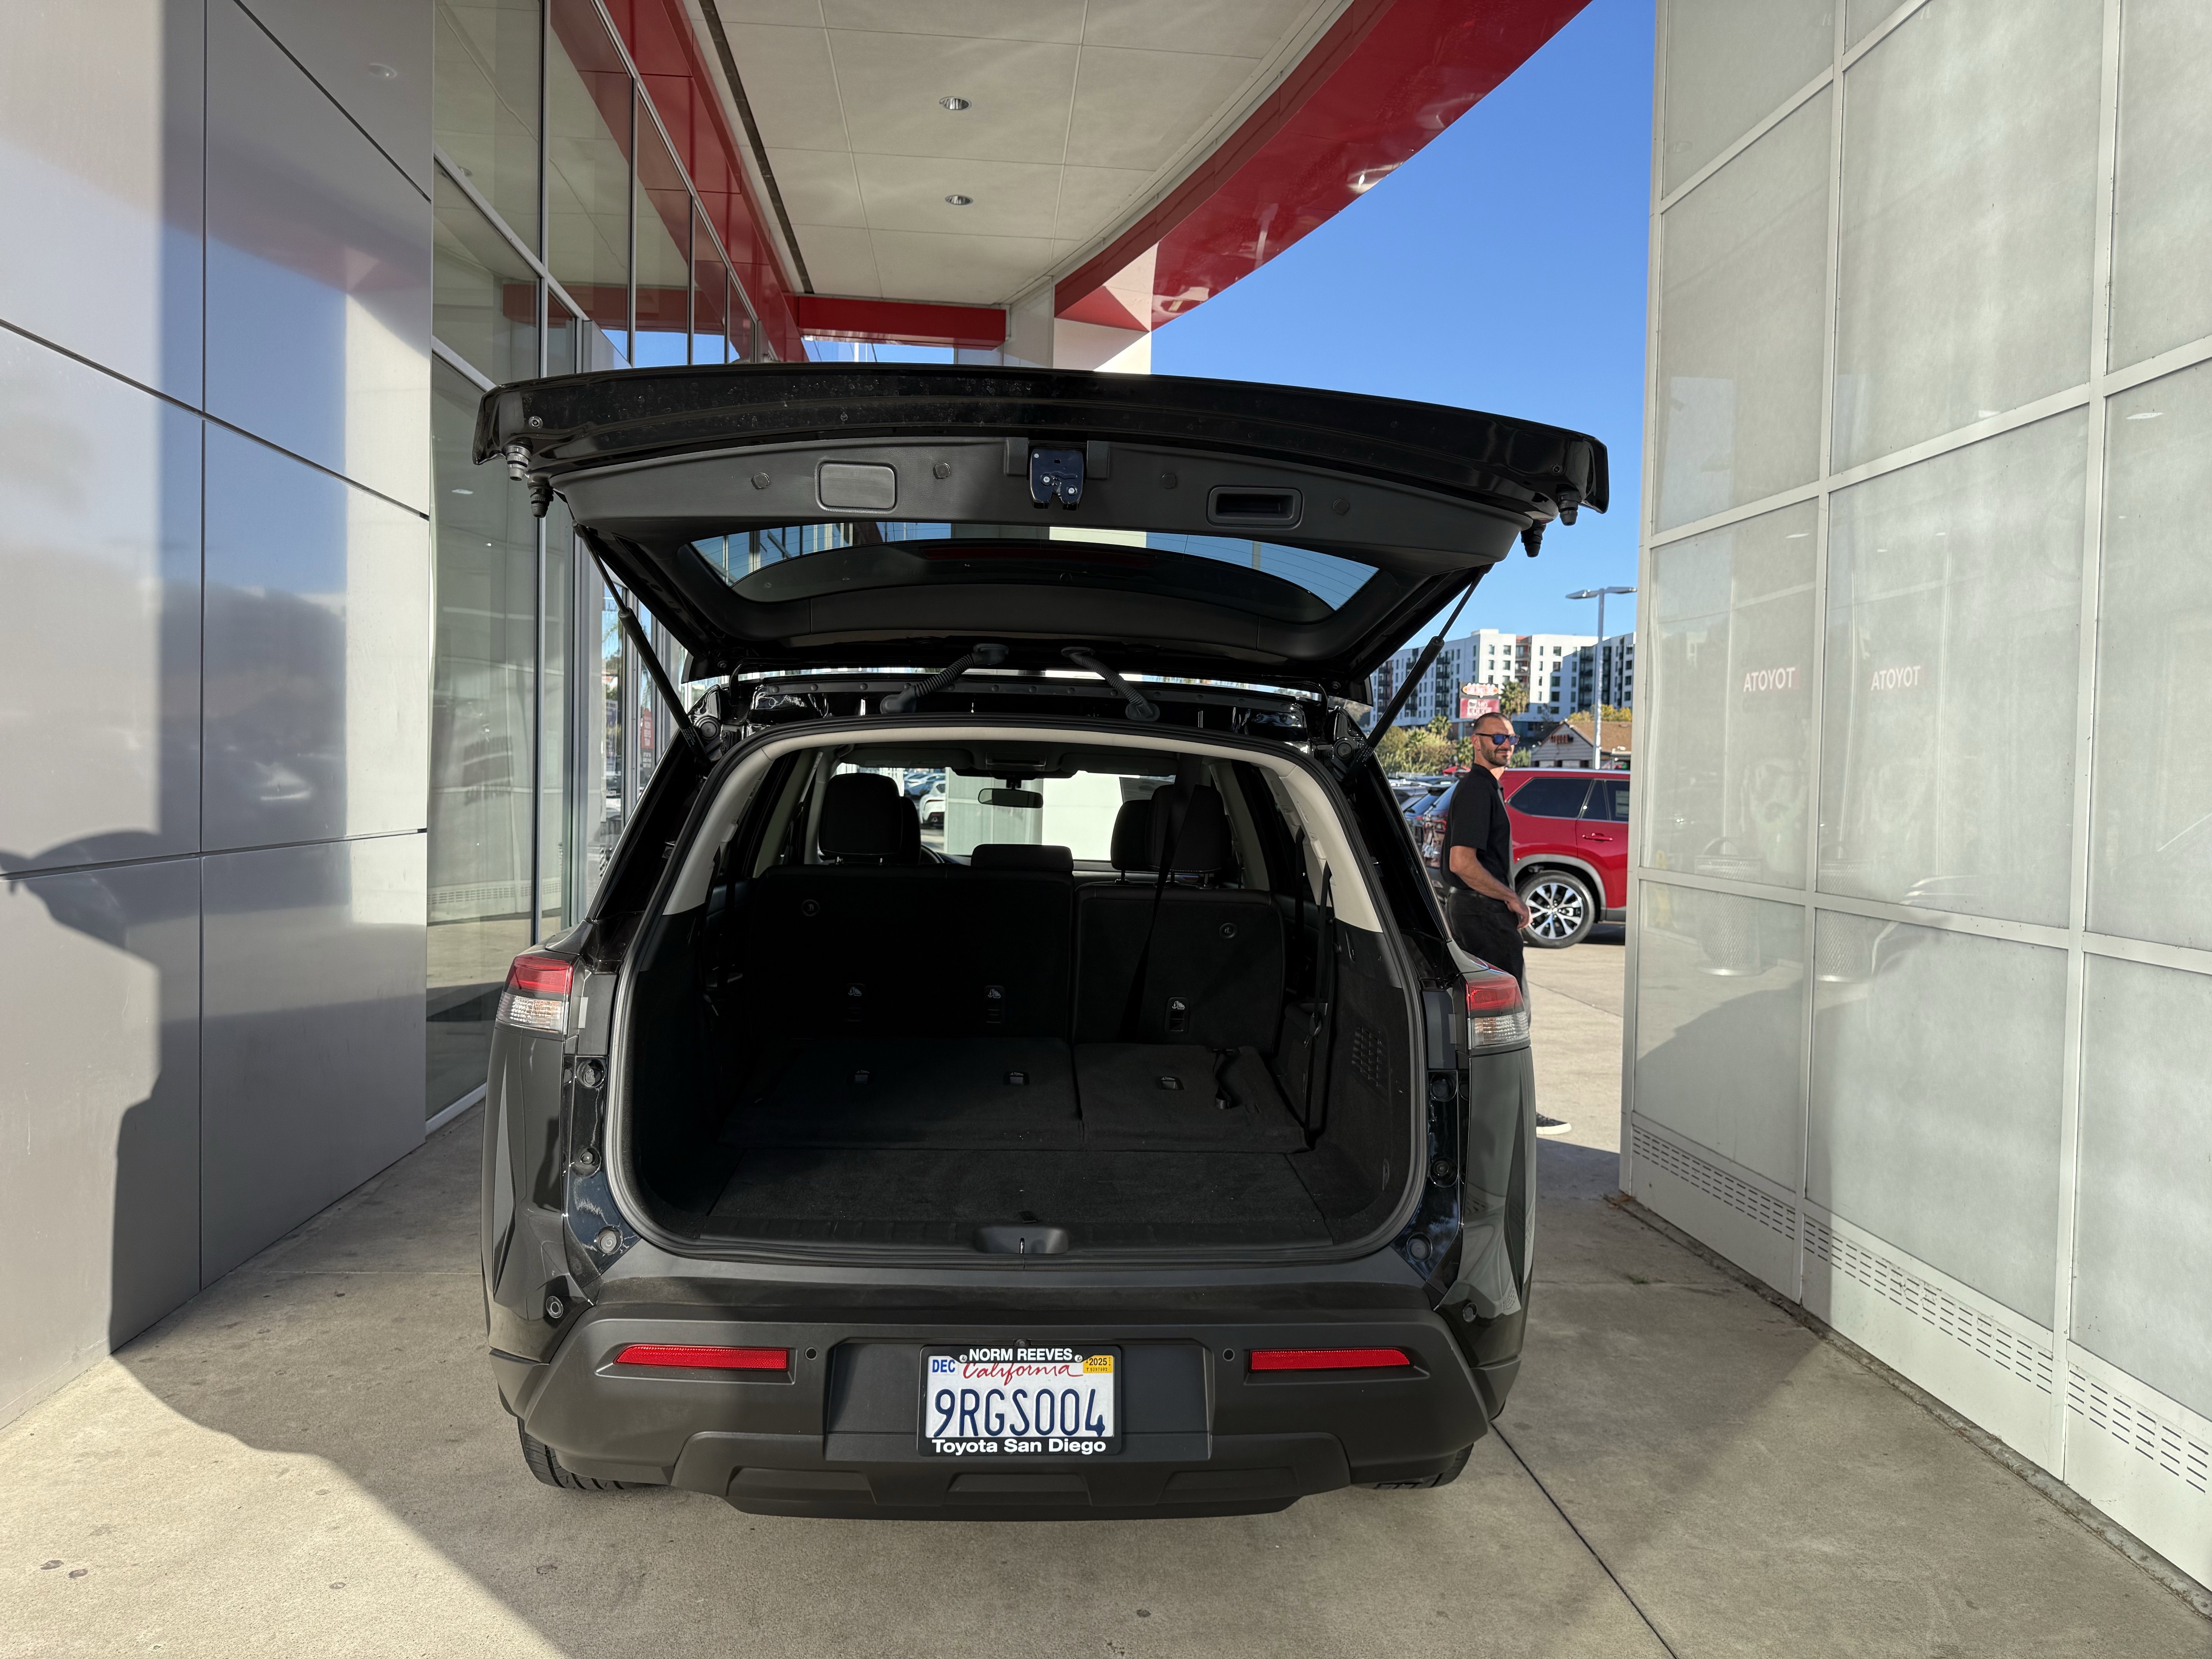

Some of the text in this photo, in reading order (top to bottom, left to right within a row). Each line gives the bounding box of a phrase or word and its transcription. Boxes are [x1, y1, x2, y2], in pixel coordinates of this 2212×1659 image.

[969, 1348, 1073, 1361] NORM REEVES
[932, 1359, 955, 1373] DEC
[963, 1363, 1083, 1386] California
[933, 1389, 1105, 1437] 9RGS004
[932, 1438, 1106, 1456] Toyota San Diego
